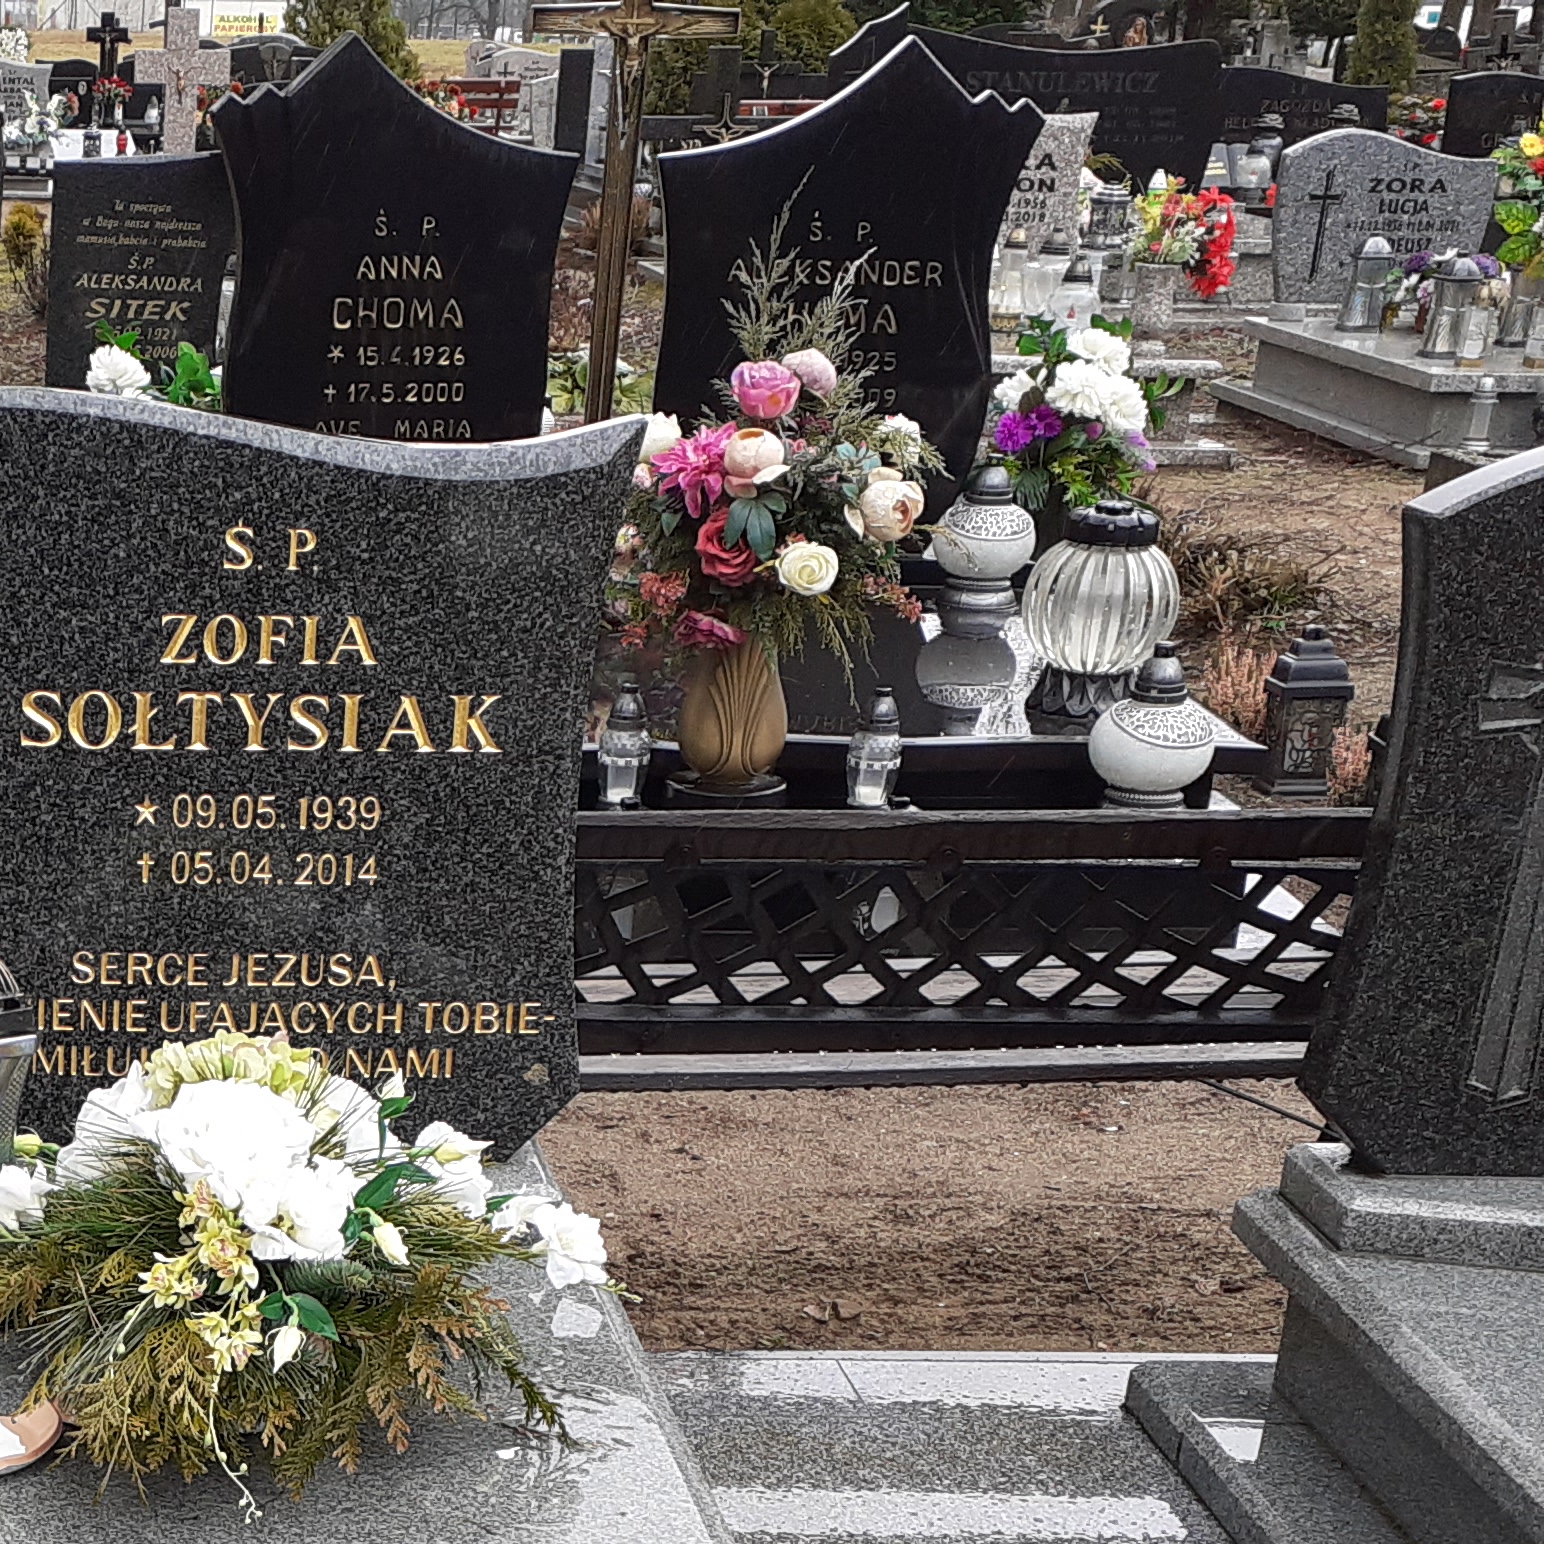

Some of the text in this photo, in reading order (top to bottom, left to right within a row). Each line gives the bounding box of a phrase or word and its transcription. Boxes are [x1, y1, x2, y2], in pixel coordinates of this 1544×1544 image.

[219, 15, 272, 23] ALKOHL
[966, 71, 1160, 93] STANULEWICZ
[1368, 177, 1448, 194] ZORA
[421, 216, 441, 237] P.
[856, 221, 874, 242] P.
[356, 256, 443, 280] ANNA
[727, 257, 943, 287] ALEKSANDER
[75, 273, 205, 293] ALEKSANDRA
[85, 298, 192, 321] SITEK
[333, 297, 465, 330] CHOMA
[347, 383, 465, 403] 17.5.2000
[394, 419, 472, 439] MARIA
[159, 613, 379, 666] ZOFIA
[19, 689, 504, 753] SOŁTYSIAK
[172, 794, 382, 831] 09.05.1939
[170, 850, 379, 885] 05.04.2014
[70, 951, 398, 993] SERCE JEZUSA,
[37, 998, 148, 1032] IENIE
[344, 1047, 454, 1079] NAMI
